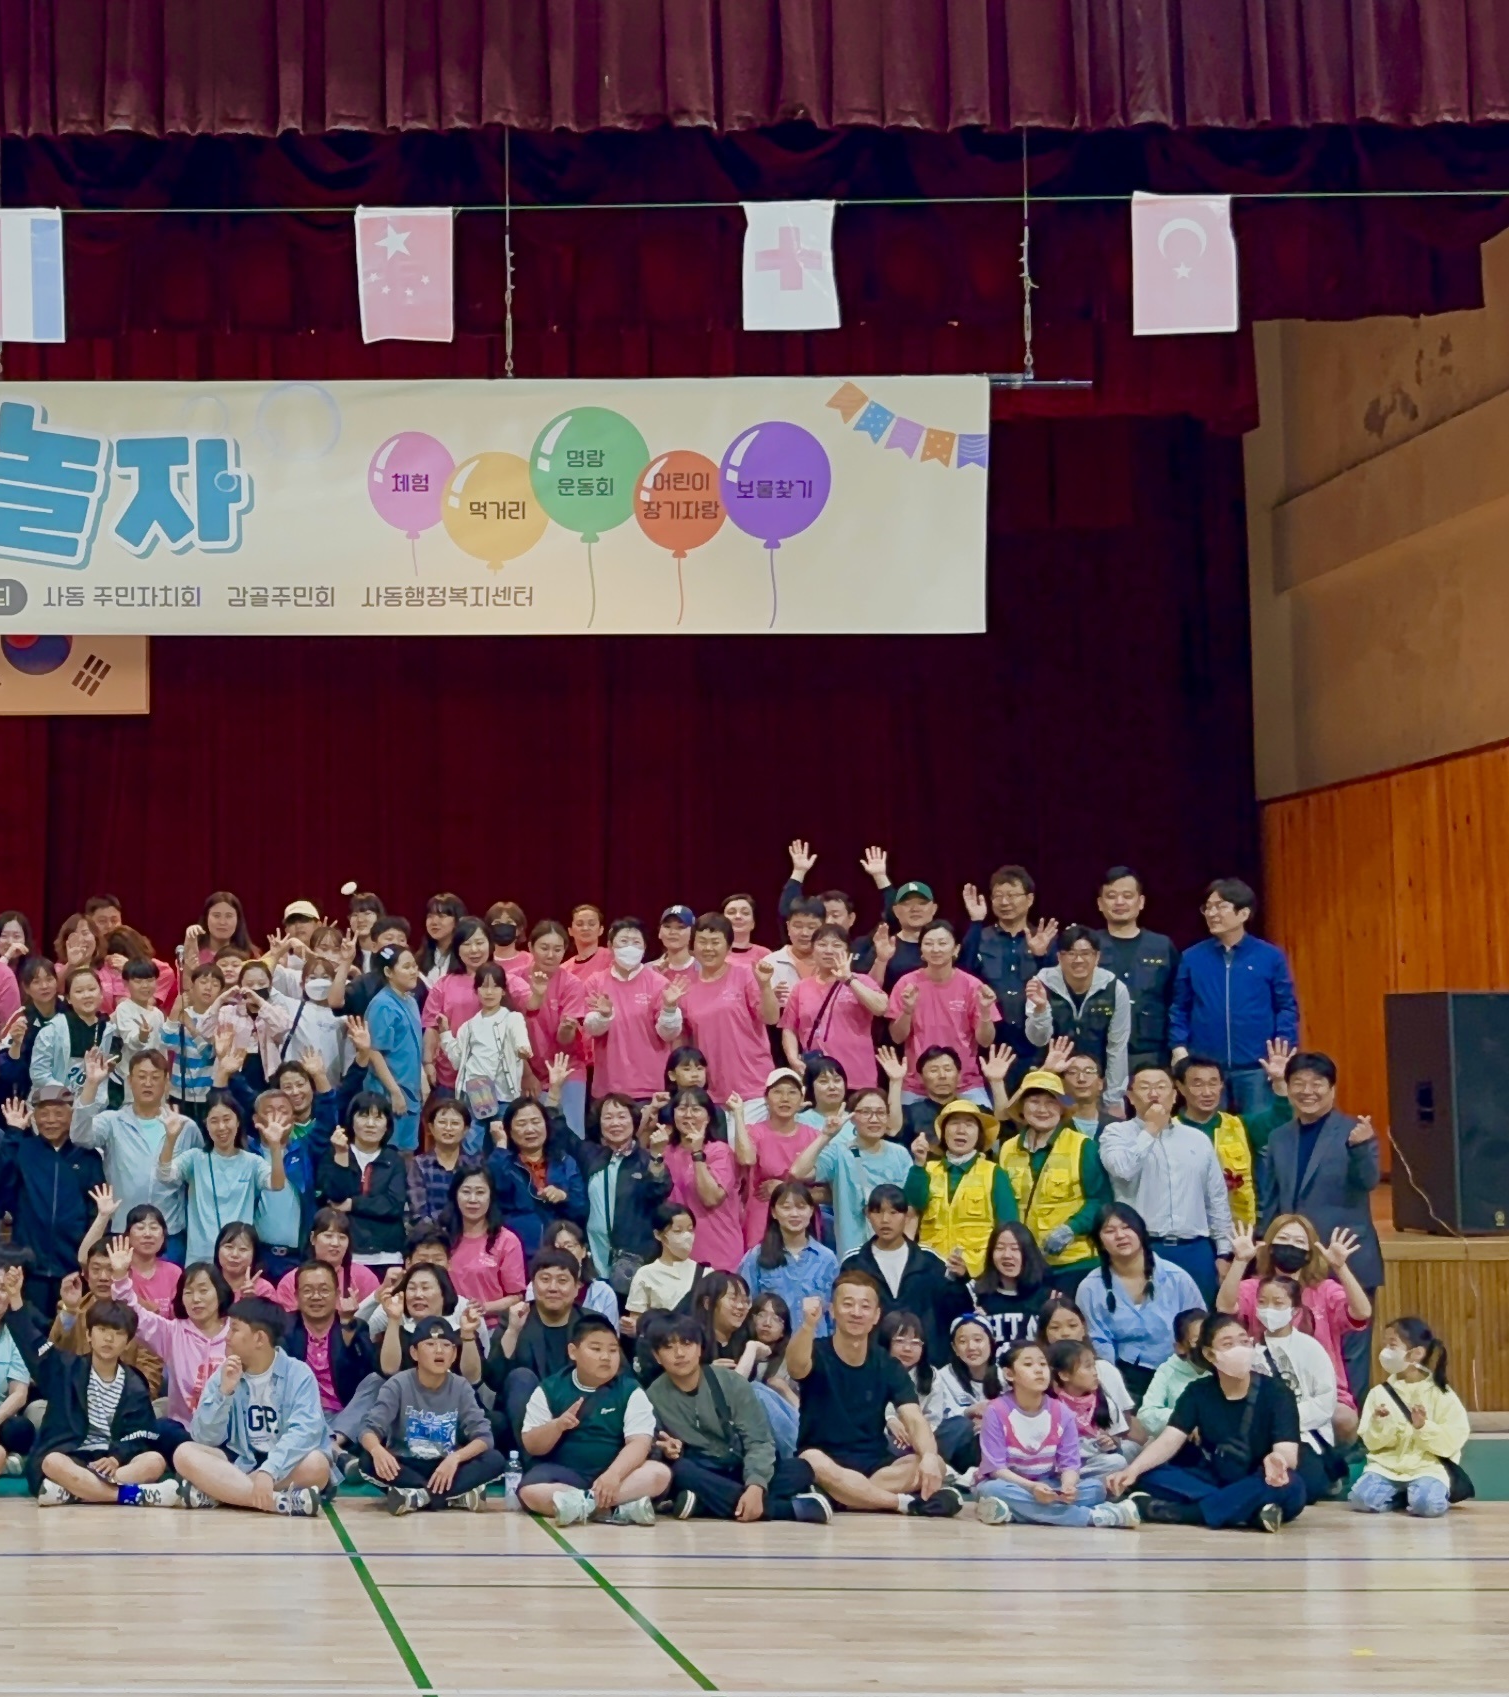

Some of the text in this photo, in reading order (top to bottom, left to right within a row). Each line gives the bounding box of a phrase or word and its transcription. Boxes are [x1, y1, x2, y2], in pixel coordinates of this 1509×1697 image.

[565, 449, 605, 468] 명랑
[391, 473, 430, 493] 체험
[557, 476, 614, 498] 운동회
[652, 472, 711, 493] 어린이
[736, 479, 813, 501] 보물찾기
[469, 500, 527, 520] 먹거리
[643, 500, 720, 521] 장기자랑
[43, 585, 534, 608] 사동 주민자치회 감골주민회 사동행정복지센터
